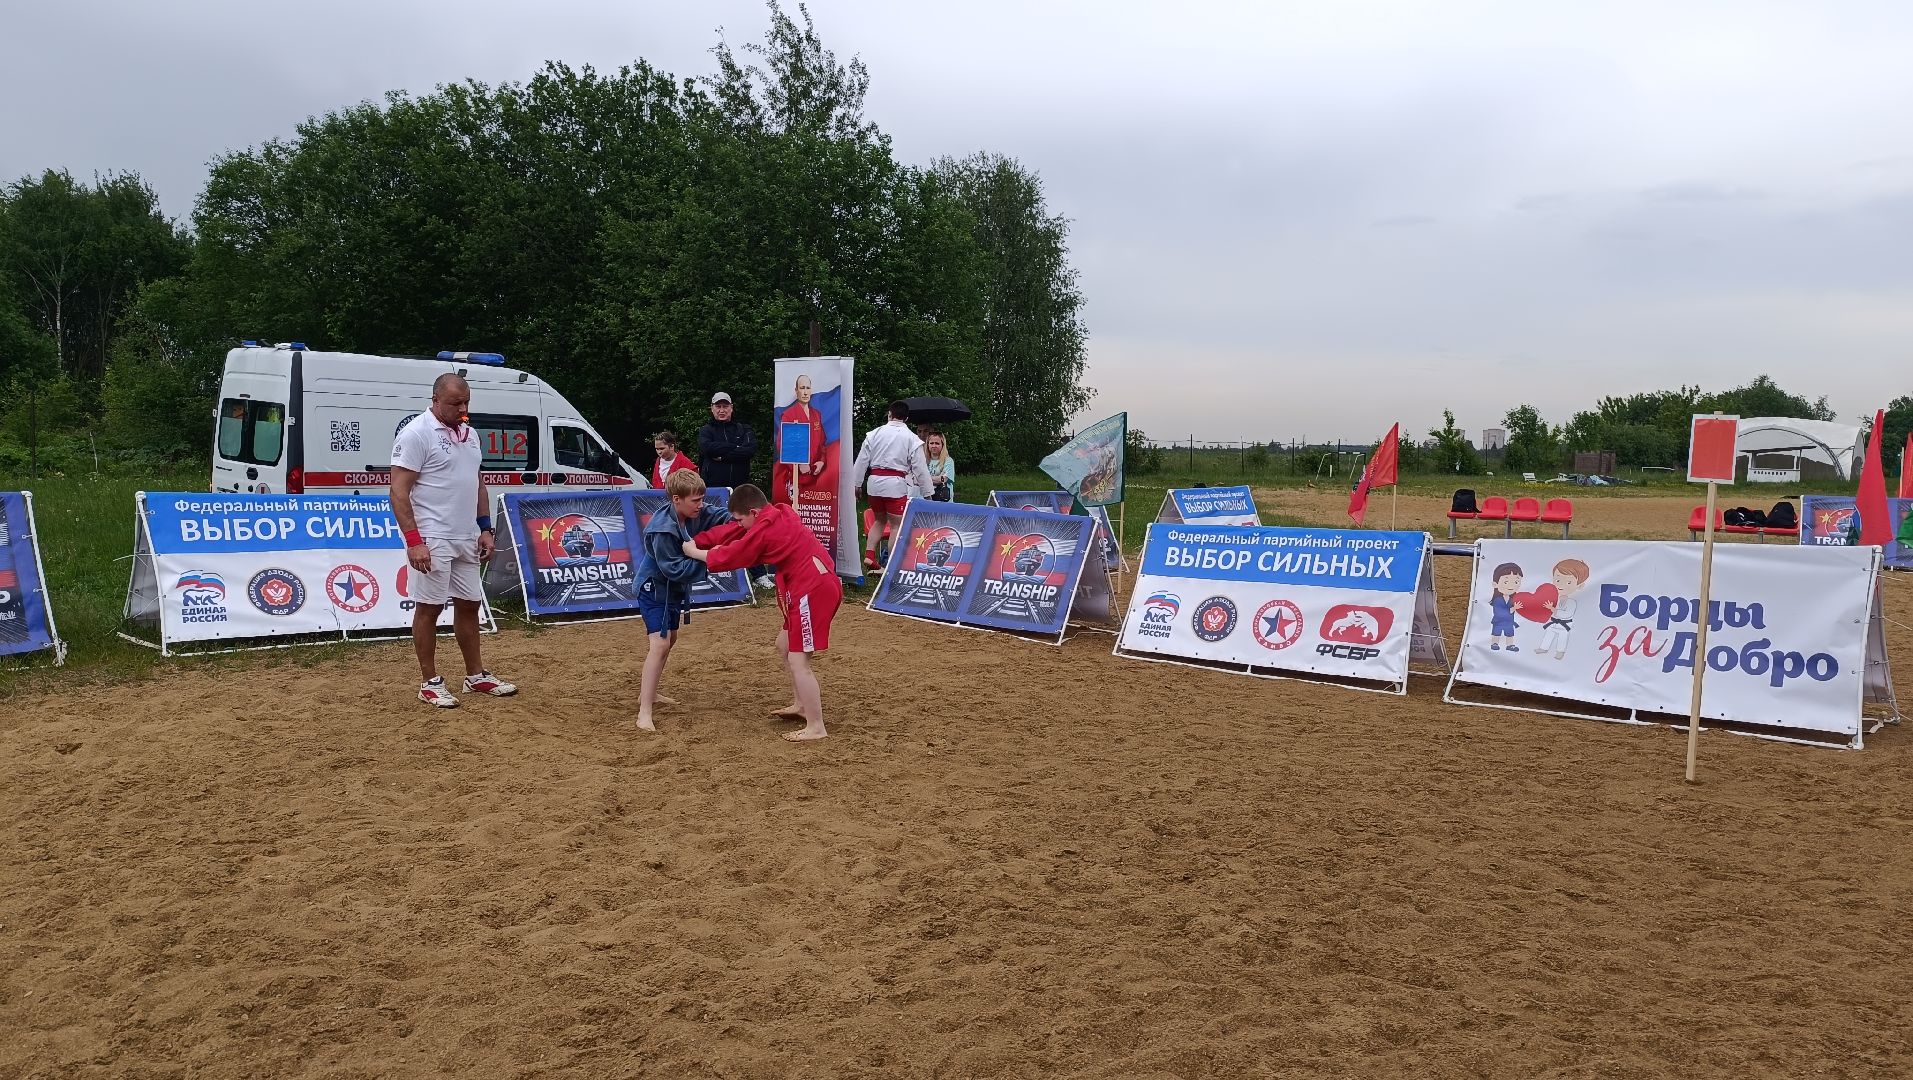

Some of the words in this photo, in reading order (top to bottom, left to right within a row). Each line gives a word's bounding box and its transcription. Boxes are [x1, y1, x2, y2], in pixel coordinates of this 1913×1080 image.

[487, 432, 528, 455] 112
[344, 473, 391, 484] СКОРАЯ
[480, 474, 510, 484] СКАЯ
[568, 474, 609, 484] ПОМОЩЬ
[174, 499, 299, 514] Федеральный
[303, 499, 391, 514] партийный
[1185, 501, 1213, 513] ВЫБОР
[1213, 499, 1249, 511] СИЛЬНЫХ
[180, 517, 296, 542] ВЫБОР
[305, 517, 401, 539] СИЛЬН
[1167, 529, 1260, 546] Федеральный
[1262, 534, 1343, 548] партийный
[1346, 539, 1399, 552] проект
[1164, 546, 1251, 571] ВЫБОР
[1257, 550, 1394, 579] СИЛЬНЫХ
[539, 562, 628, 584] TRANSHIP
[898, 569, 964, 590] TRANSHIP
[983, 578, 1058, 601] TRANSHIP
[181, 606, 227, 616] ЕДИНАЯ
[338, 601, 374, 612] САМБО
[1599, 584, 1768, 632] Борцы
[182, 614, 228, 624] РОССИЯ
[1139, 622, 1172, 632] ЕДИНАЯ
[1138, 629, 1171, 639] РОССИЯ
[1315, 644, 1381, 660] ФСБР
[1595, 625, 1668, 684] за
[1662, 631, 1839, 688] Добро
